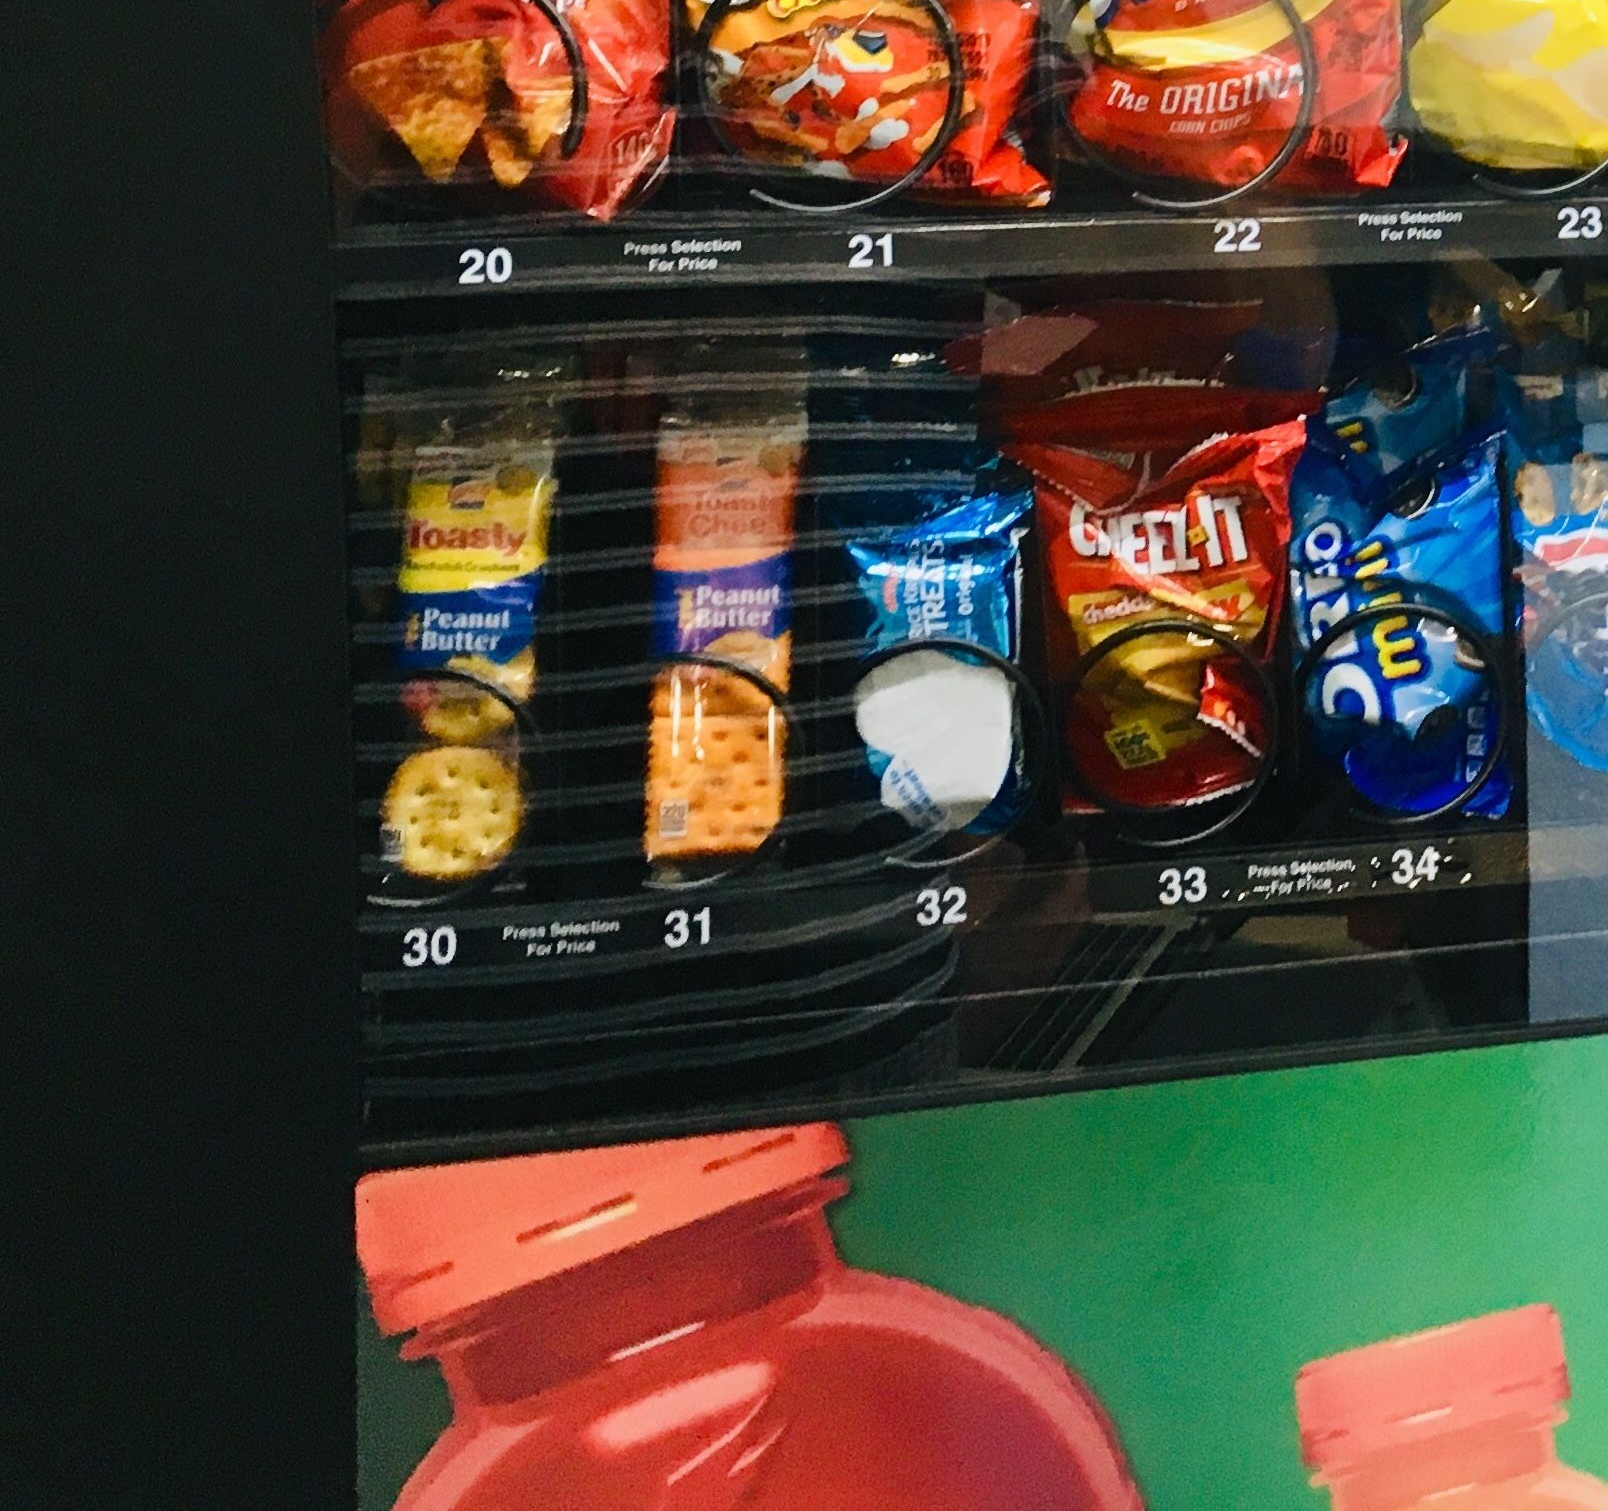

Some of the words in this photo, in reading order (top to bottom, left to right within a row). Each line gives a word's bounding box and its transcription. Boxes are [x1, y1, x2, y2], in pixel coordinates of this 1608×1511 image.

[1106, 78, 1150, 112] The
[1158, 62, 1306, 115] ORIGINA
[1358, 212, 1398, 226] Press
[1399, 210, 1463, 224] Selection
[1380, 227, 1405, 242] For
[1407, 226, 1443, 240] Price
[1557, 206, 1603, 240] 23
[624, 241, 668, 256] Press
[670, 238, 742, 254] Selection
[847, 233, 895, 269] 21
[1213, 218, 1263, 253] 22
[457, 248, 514, 284] 20
[648, 257, 676, 272] For
[678, 256, 719, 271] Price
[408, 518, 528, 558] Toasty
[695, 583, 781, 607] Peanut
[919, 538, 949, 638] TREATS
[422, 606, 511, 630] Peanut
[694, 606, 775, 630] Butter
[420, 630, 502, 653] Butter
[1391, 846, 1440, 884] 34
[1157, 866, 1208, 906] 33
[916, 886, 968, 927] 32
[502, 924, 546, 941] Press
[550, 920, 620, 939] Selection
[663, 906, 712, 949] 31
[401, 924, 458, 967] 30
[525, 941, 553, 957] For
[556, 939, 597, 955] Price
